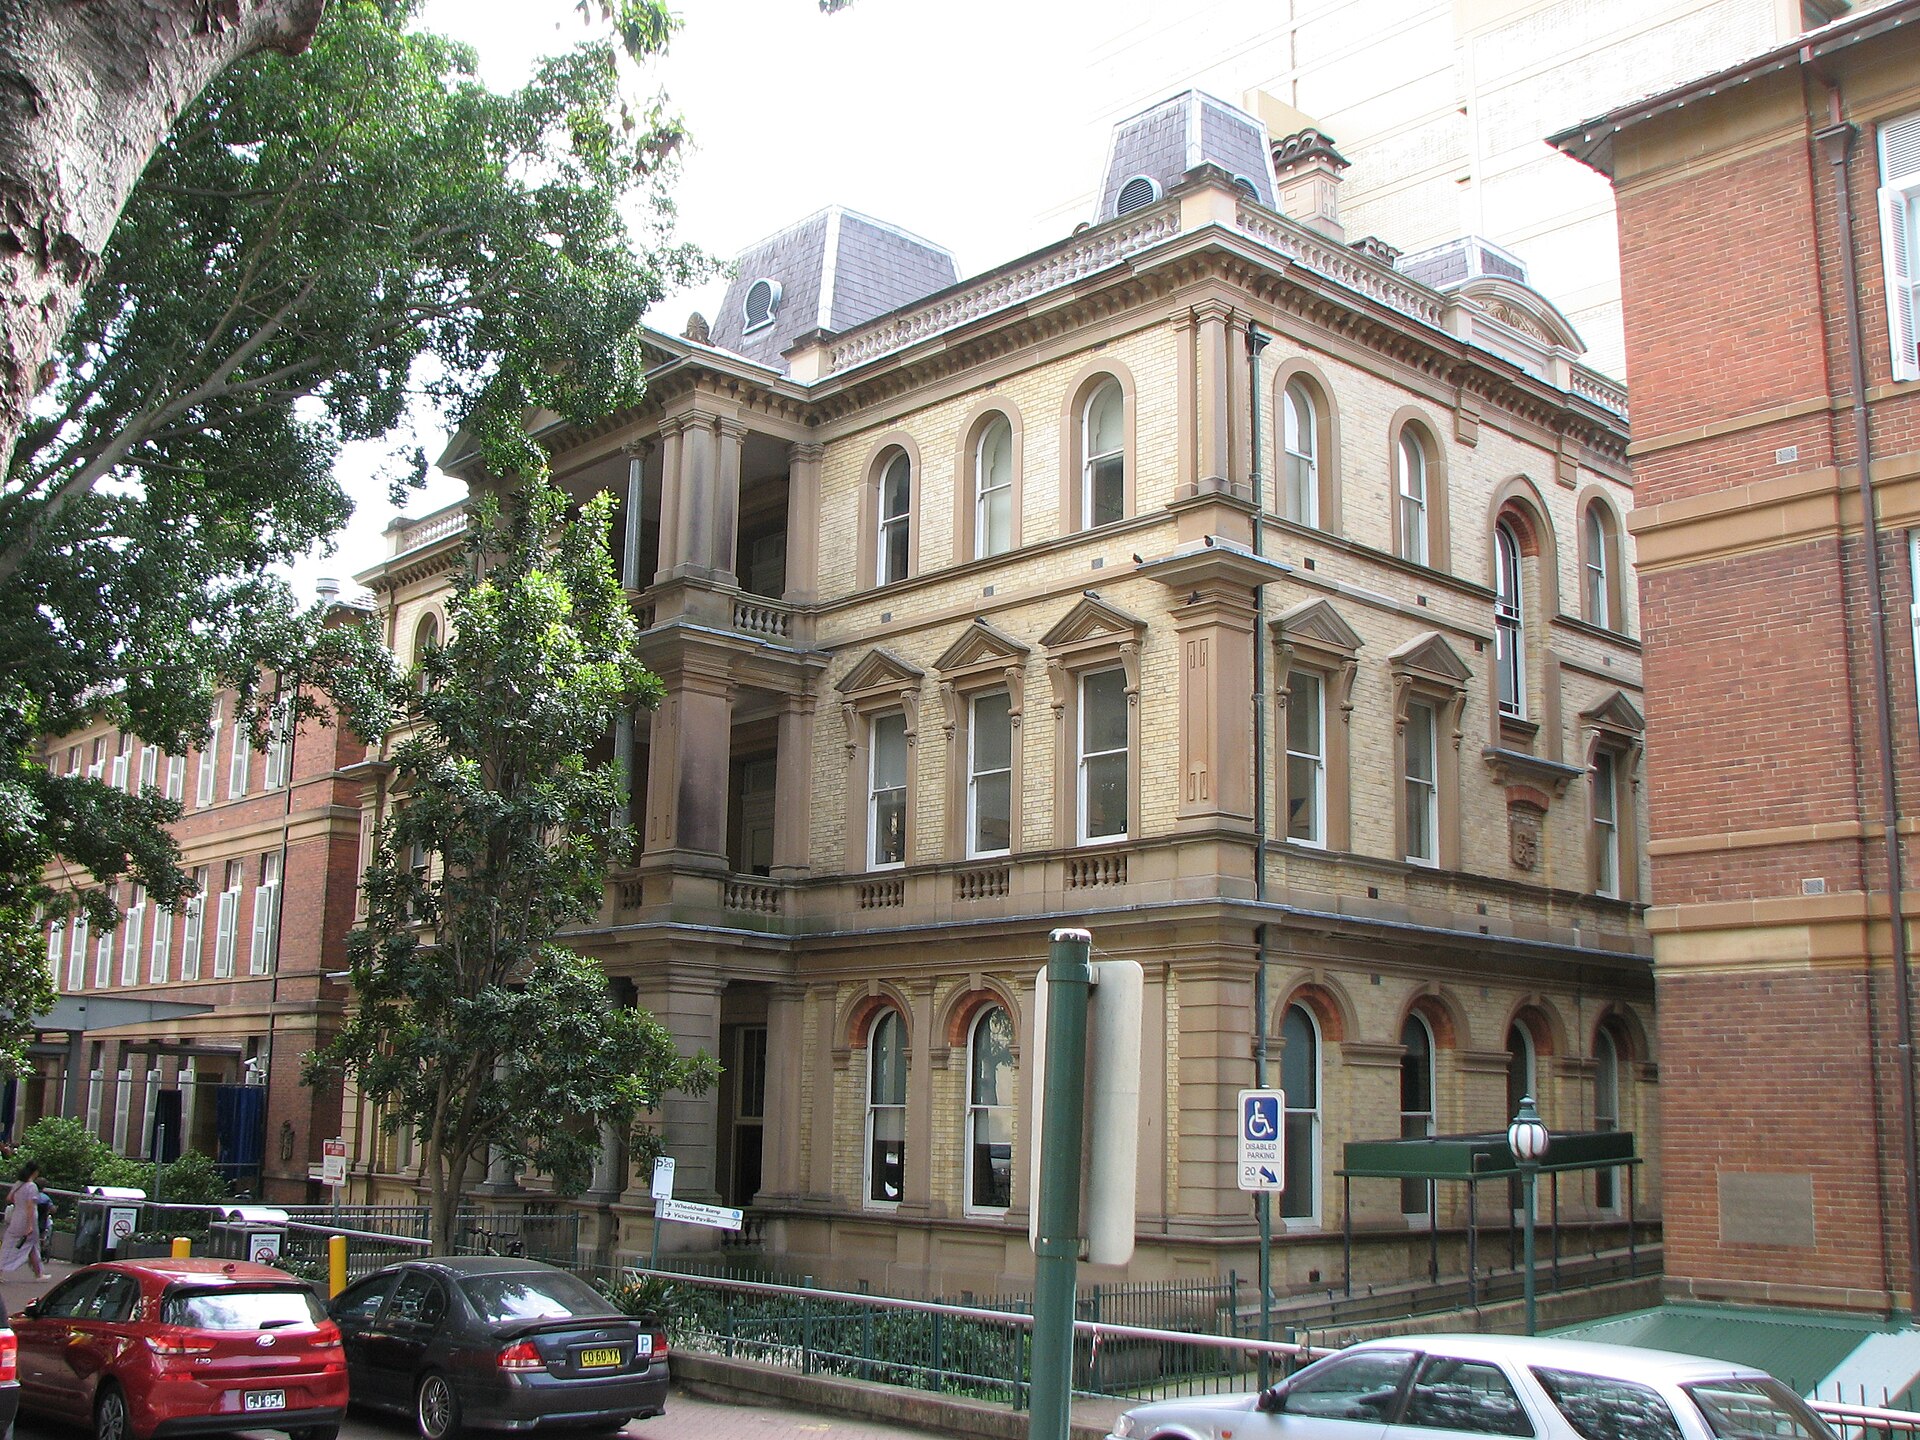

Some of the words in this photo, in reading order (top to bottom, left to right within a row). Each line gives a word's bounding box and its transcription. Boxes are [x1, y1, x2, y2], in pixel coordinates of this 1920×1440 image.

[1245, 1143, 1277, 1151] DISABLED
[656, 1159, 663, 1170] P
[1245, 1166, 1256, 1175] 20
[674, 1202, 705, 1212] Wheelchair
[705, 1207, 721, 1215] Ramp
[673, 1212, 696, 1221] Victoria
[696, 1216, 718, 1224] Pavilion
[641, 1337, 649, 1351] P
[609, 1349, 619, 1360] YX
